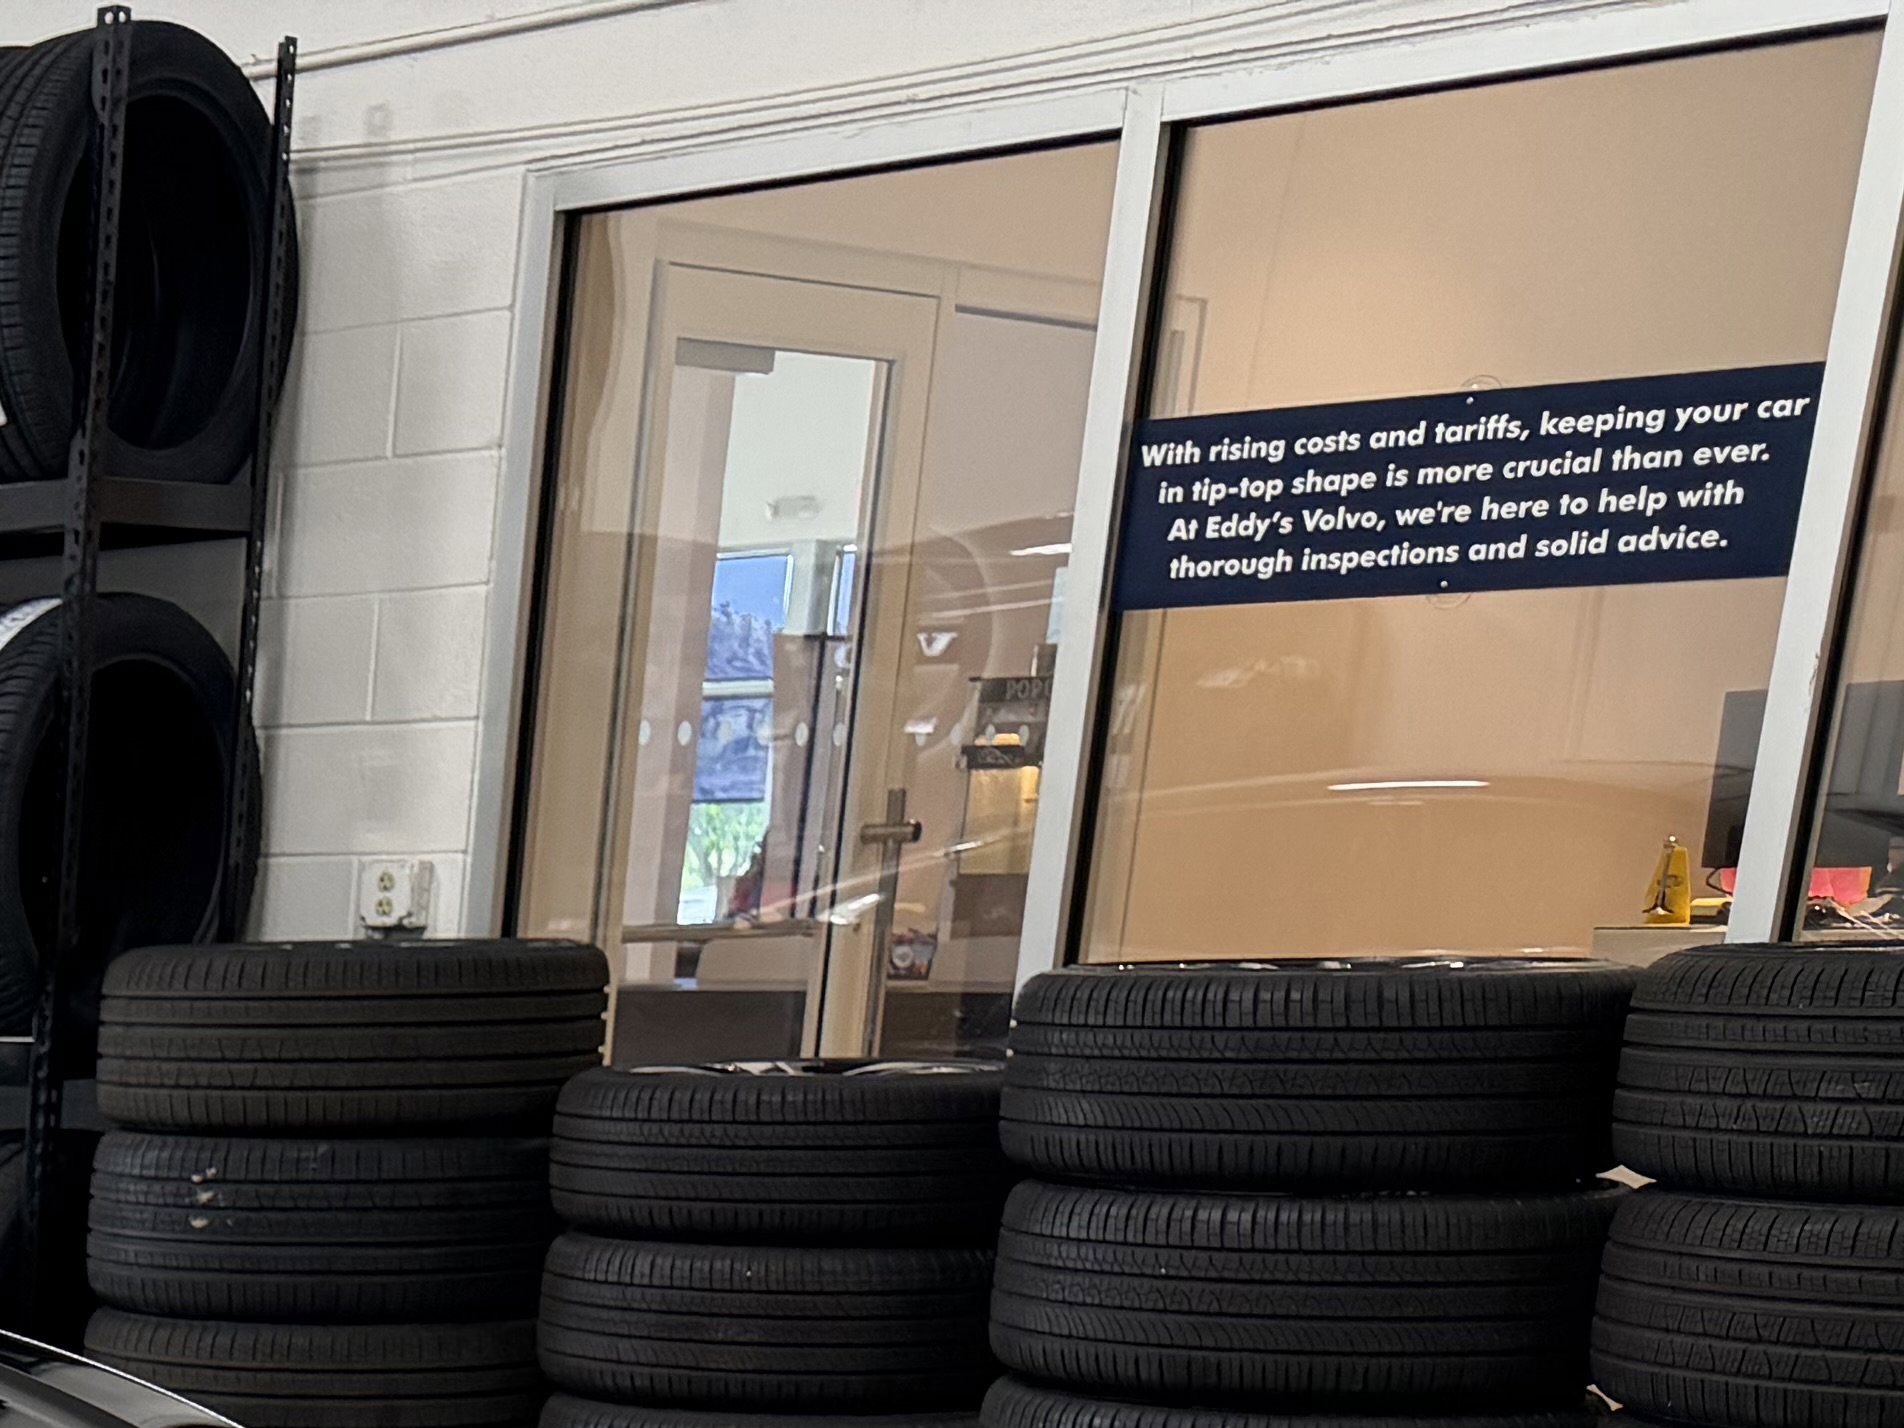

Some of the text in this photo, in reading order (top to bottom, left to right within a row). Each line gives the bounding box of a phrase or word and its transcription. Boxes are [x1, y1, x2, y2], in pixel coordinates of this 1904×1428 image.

[1141, 396, 1811, 468] With rising costs and tariffs, keeping your car
[1158, 442, 1771, 507] in tip-top shape is more crucial than ever.
[1166, 478, 1745, 542] At Eddy's Volvo, we're here to help with
[1169, 524, 1729, 580] thorough inspections and solid advice.
